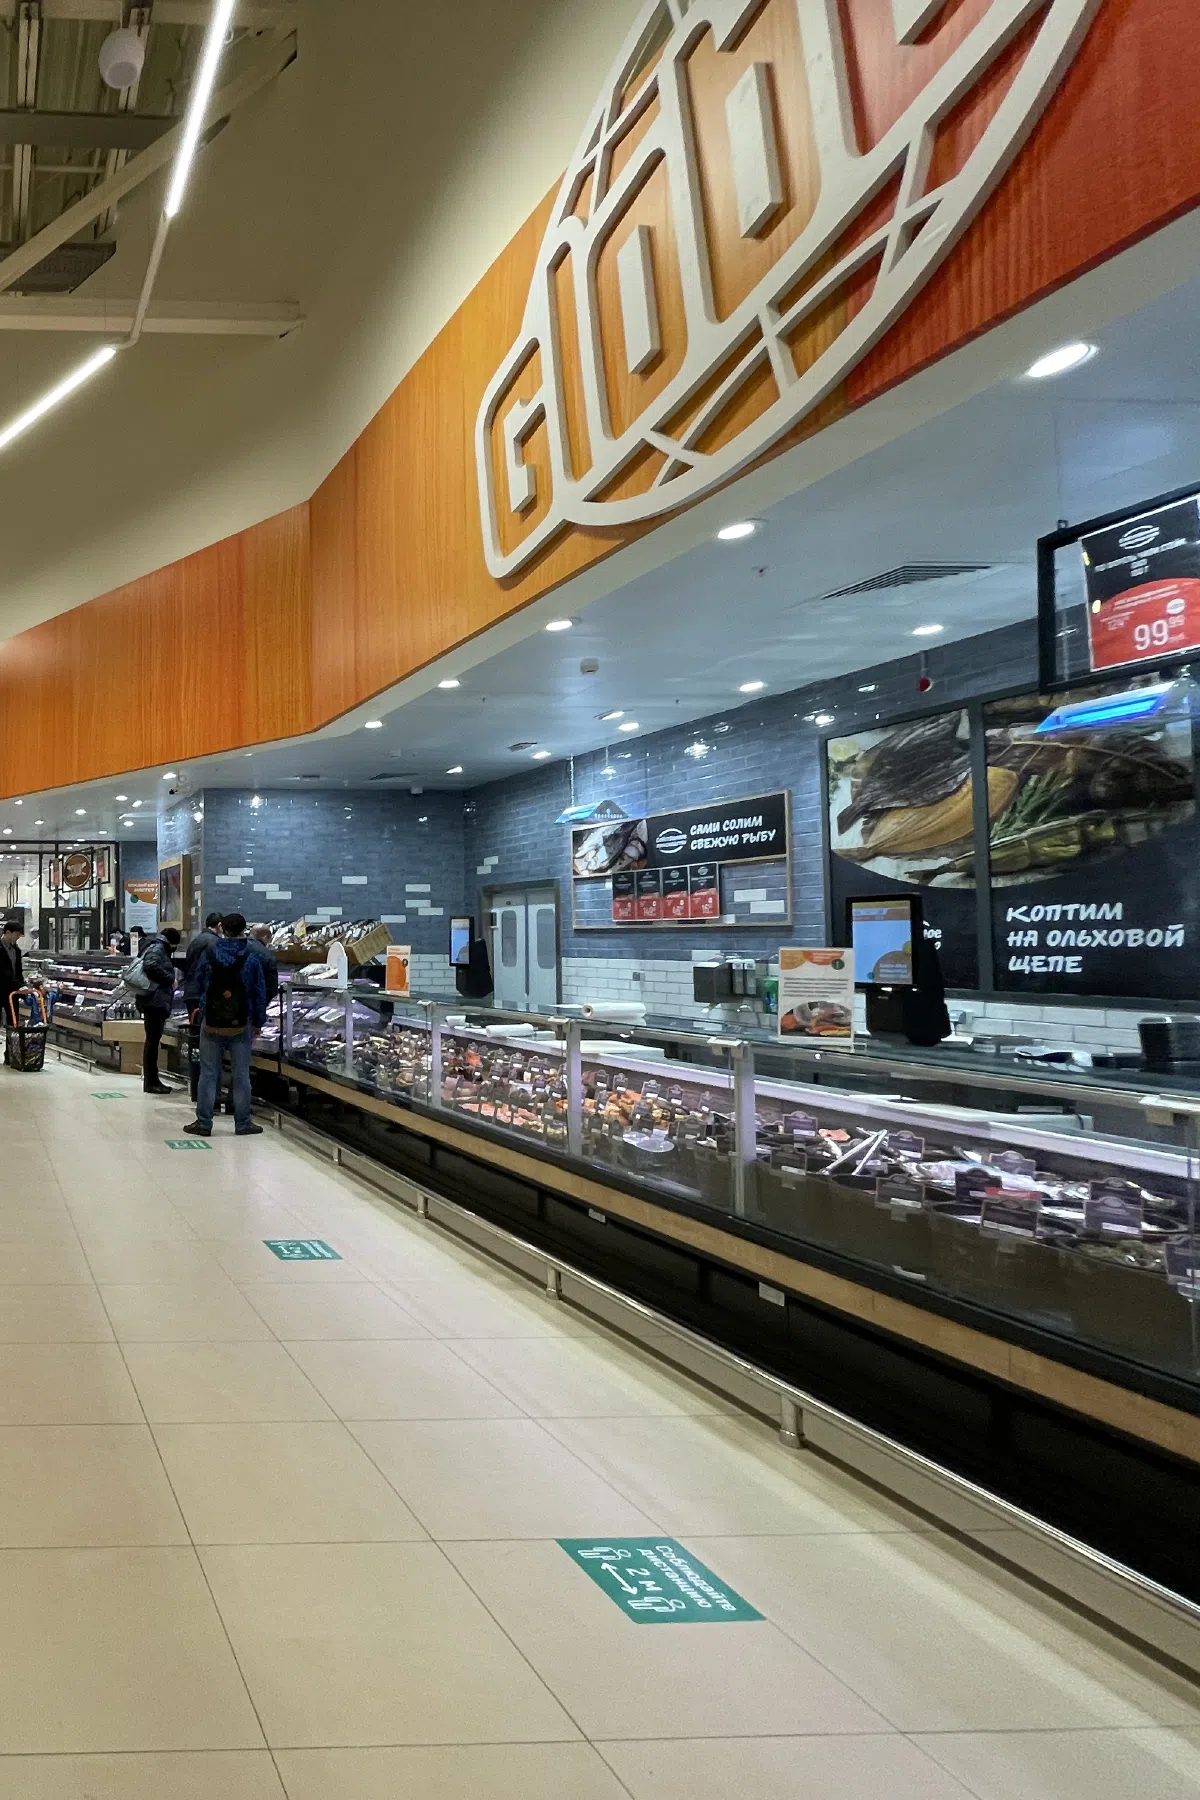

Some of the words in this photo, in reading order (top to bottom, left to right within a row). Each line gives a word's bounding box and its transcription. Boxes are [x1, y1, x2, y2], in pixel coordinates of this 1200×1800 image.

[690, 821, 720, 836] САМИ
[722, 815, 763, 832] СОЛИМ
[690, 834, 740, 851] СВЕЖУЮ
[741, 828, 776, 844] РЫБУ
[1006, 902, 1123, 923] КОПТИМ
[1007, 931, 1041, 947] НА
[1046, 924, 1185, 948] ОЛЬХОВОЙ
[1007, 955, 1083, 974] ЩЕПЕ
[625, 1567, 651, 1577] 2
